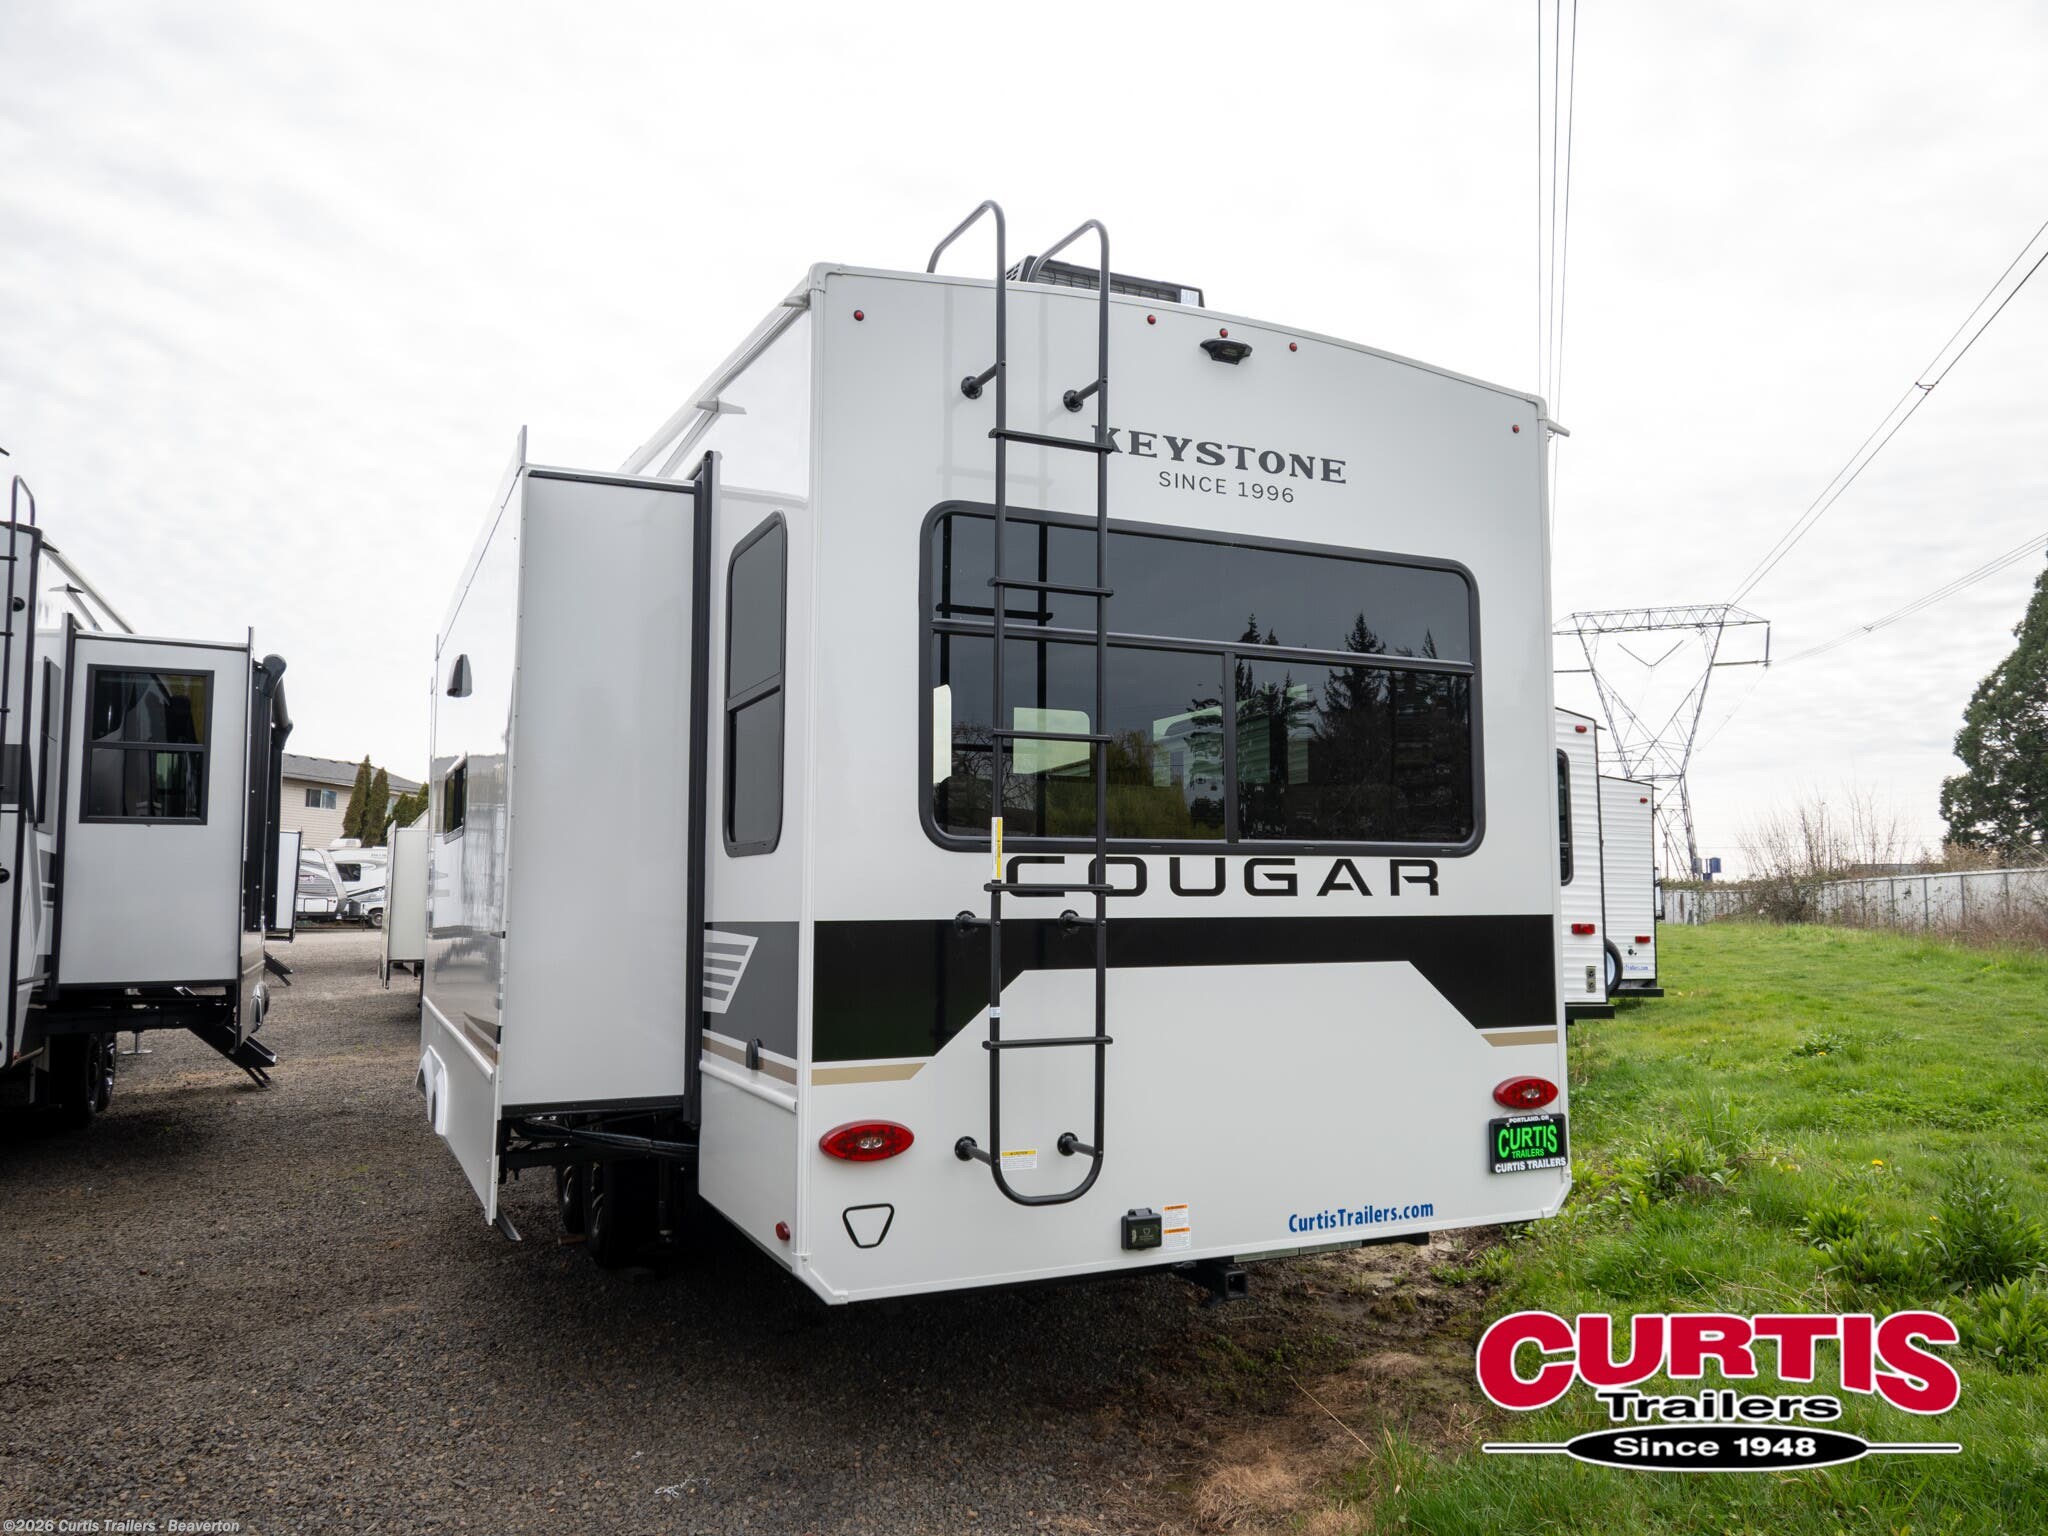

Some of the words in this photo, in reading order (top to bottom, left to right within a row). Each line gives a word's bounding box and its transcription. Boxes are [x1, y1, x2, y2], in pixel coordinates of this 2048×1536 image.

[1091, 424, 1347, 484] KEYSTONE
[1158, 471, 1227, 495] SINCE
[1237, 482, 1295, 503] 1996
[1006, 855, 1440, 898] COUGAR
[1498, 1124, 1557, 1158] CURTIS
[1512, 1149, 1544, 1158] TRAILERS
[1495, 1161, 1526, 1173] CURTIS
[1527, 1157, 1566, 1169] TRAILERS
[1288, 1203, 1434, 1233] CurtisTrailers.com
